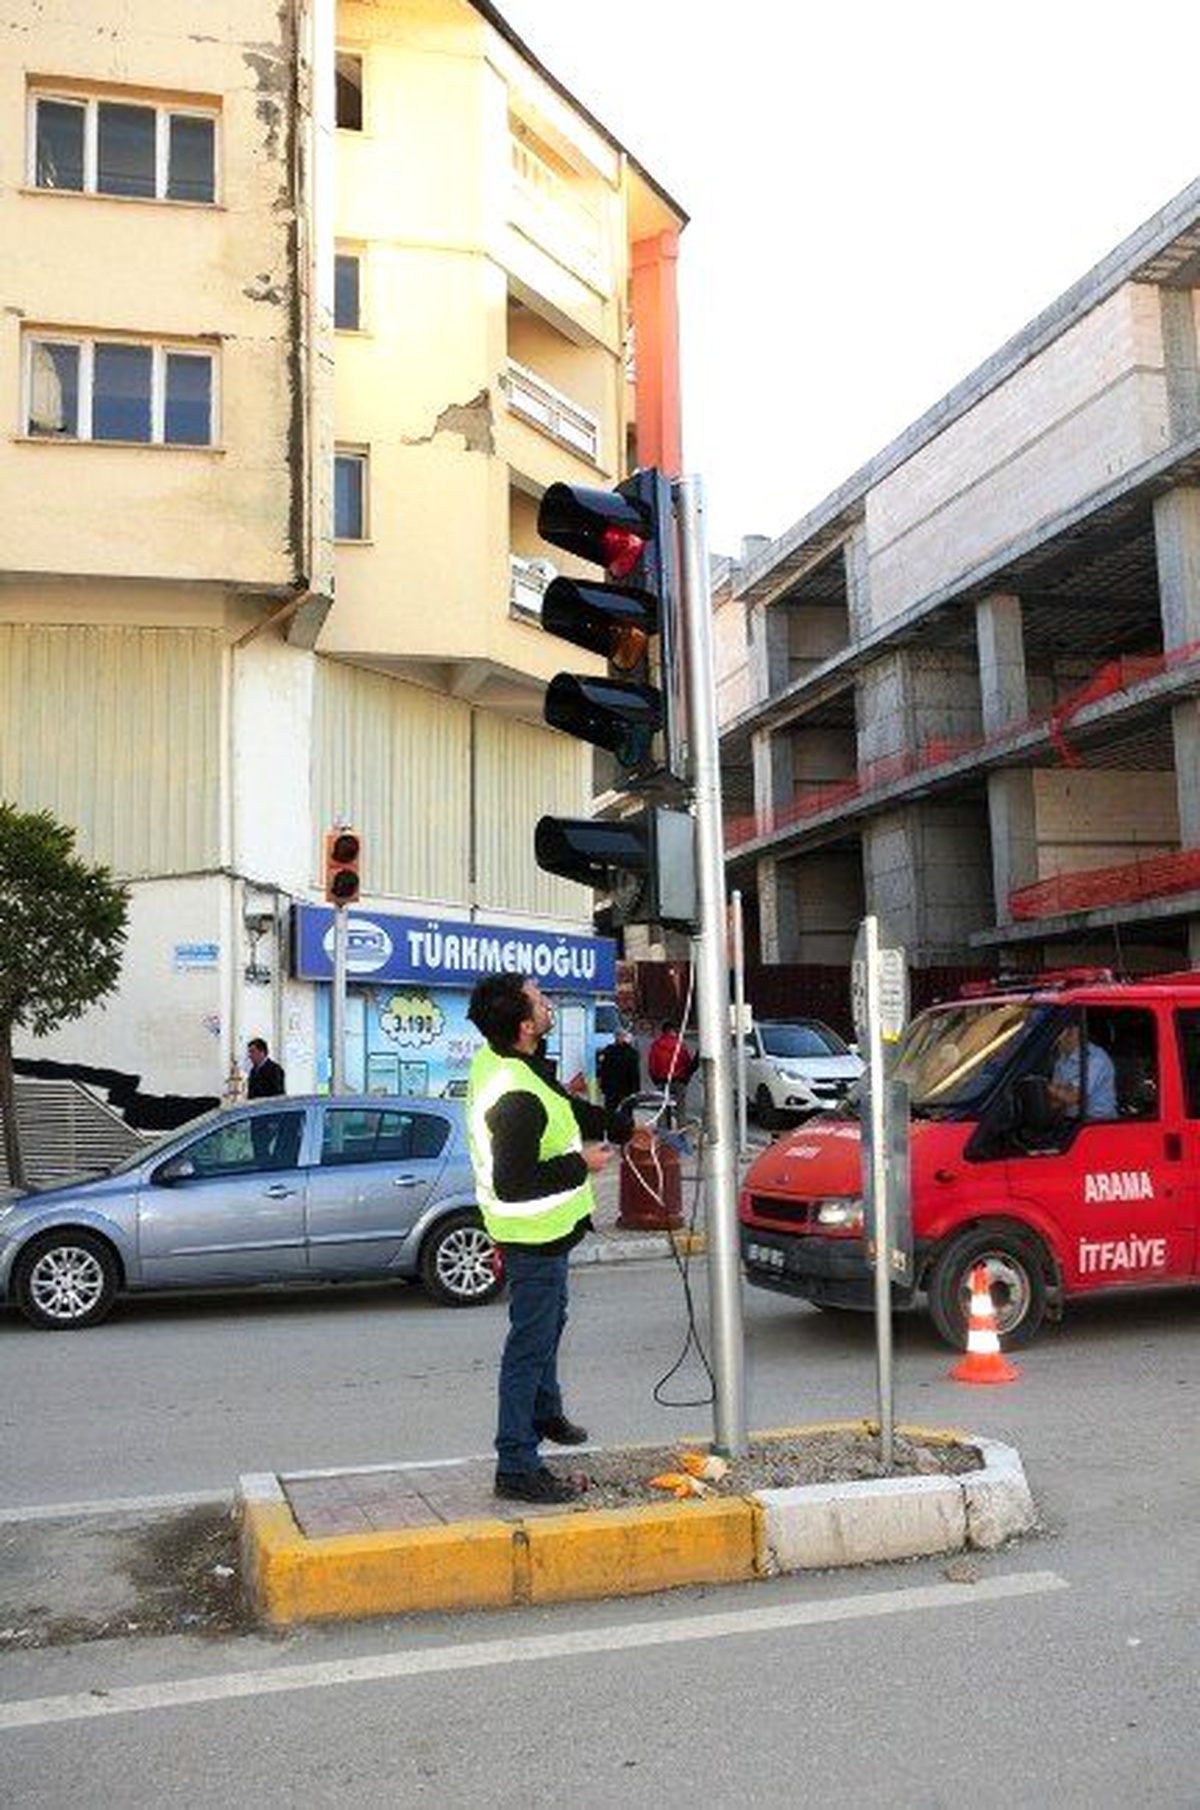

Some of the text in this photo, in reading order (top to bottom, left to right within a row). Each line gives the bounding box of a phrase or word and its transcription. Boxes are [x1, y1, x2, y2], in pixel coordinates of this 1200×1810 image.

[406, 922, 596, 979] TÜRKMENOĞLU
[1085, 1171, 1154, 1203] ARAMA
[1080, 1233, 1166, 1273] İTFAİYE
